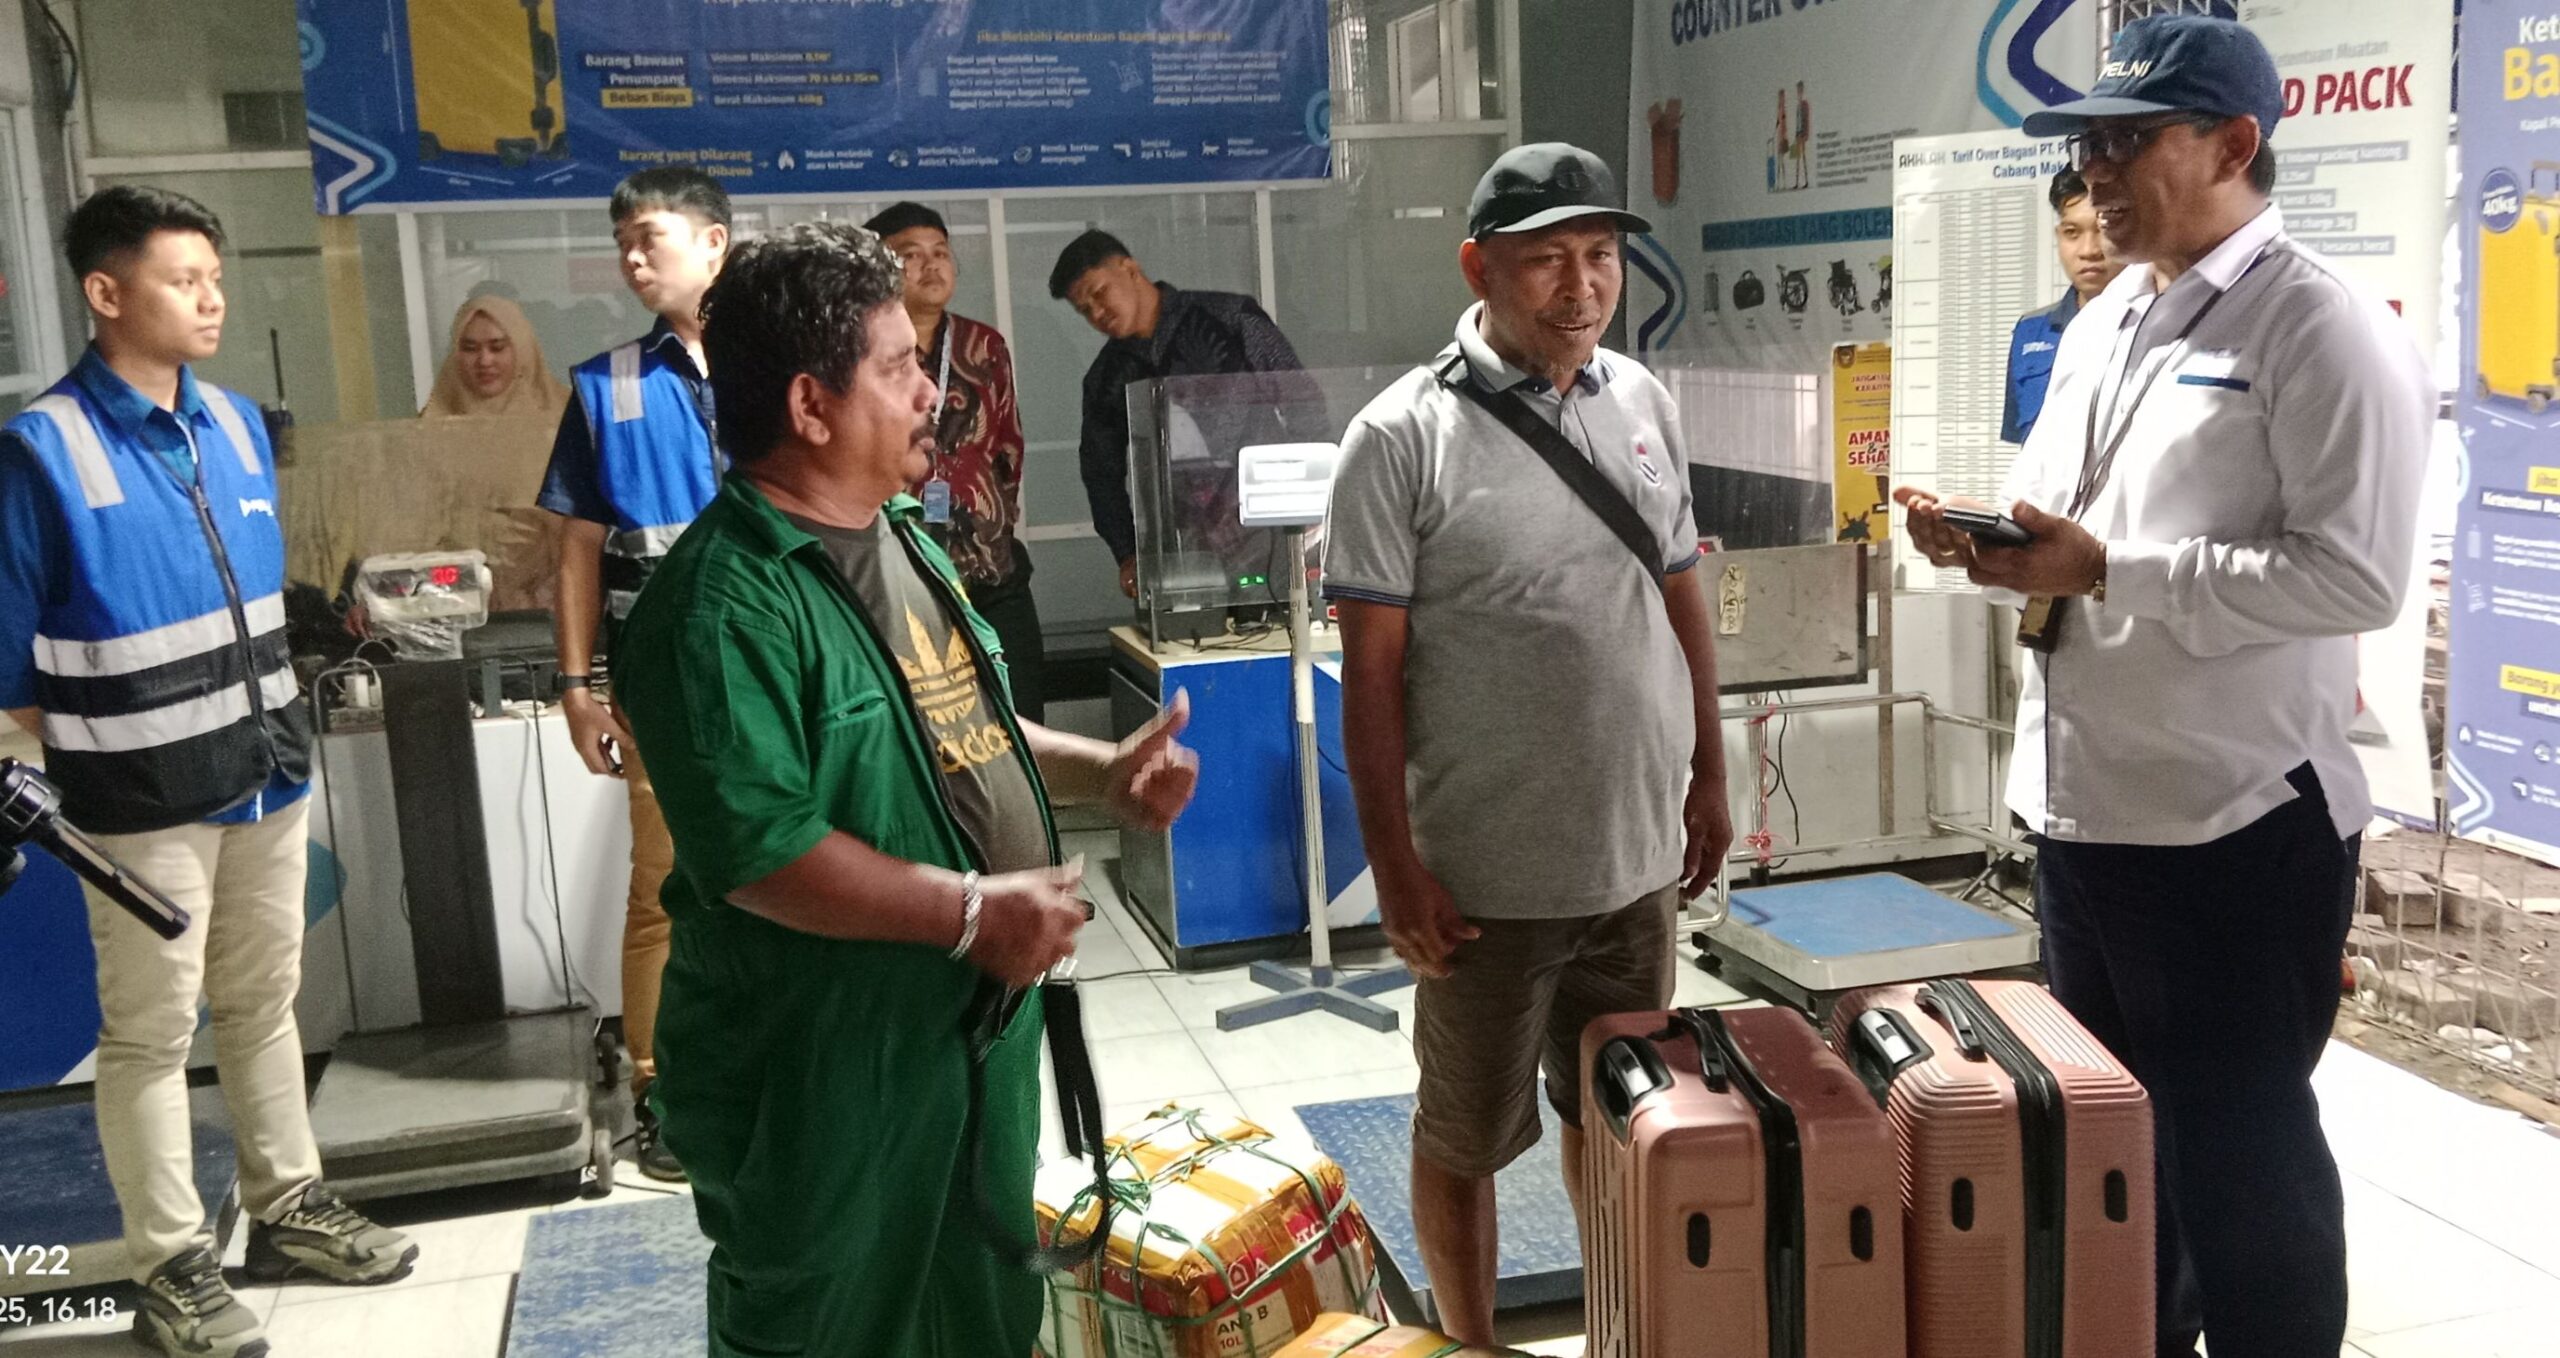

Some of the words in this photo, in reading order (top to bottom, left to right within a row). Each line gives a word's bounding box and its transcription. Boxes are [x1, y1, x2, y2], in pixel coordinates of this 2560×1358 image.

[585, 53, 631, 69] Barang
[634, 53, 684, 67] Bawaan
[610, 73, 685, 88] Penumpang
[609, 92, 648, 103] Bebas
[651, 91, 687, 105] Biaya
[2313, 64, 2416, 116] PACK
[619, 150, 664, 163] Barang
[666, 151, 697, 164] yang
[700, 149, 753, 163] Dilarang
[1952, 151, 1974, 163] Tarif
[1975, 149, 1999, 161] Over
[2002, 145, 2037, 161] Bagasi
[708, 166, 753, 178] Dibawa
[1993, 163, 2037, 179] Cabang
[2507, 670, 2548, 694] Barang
